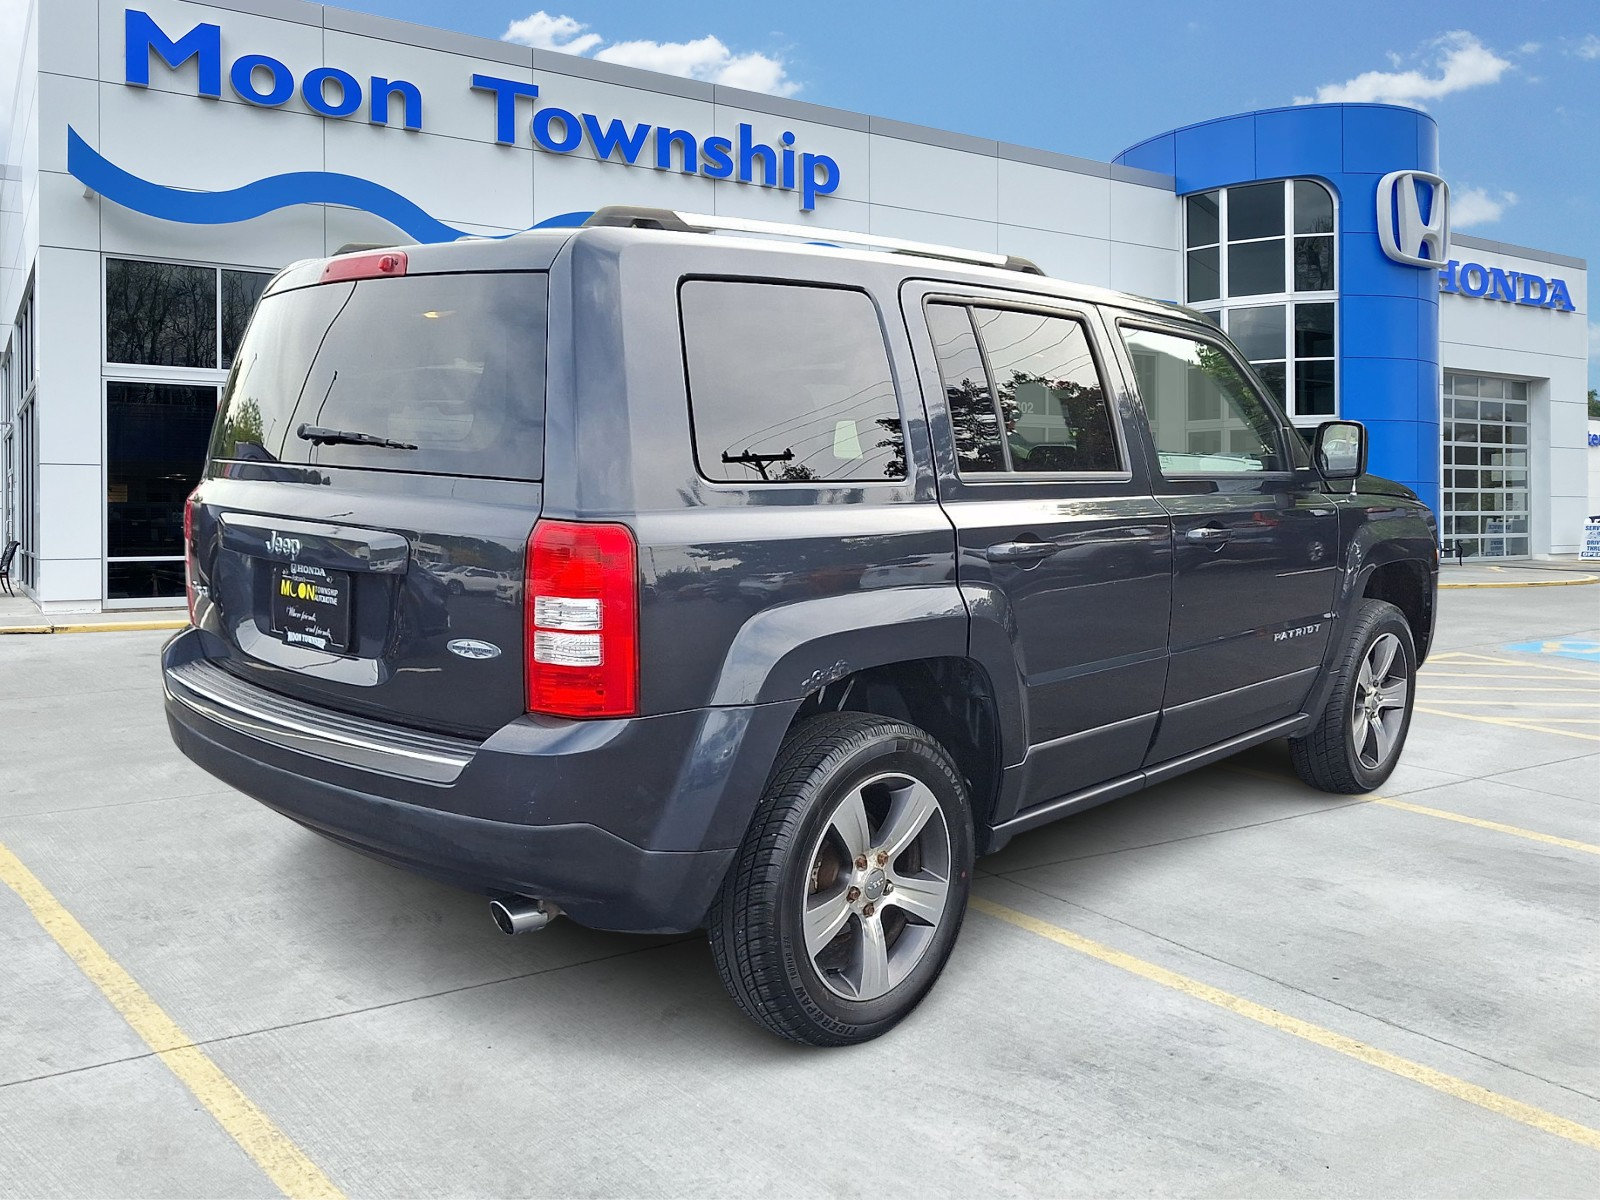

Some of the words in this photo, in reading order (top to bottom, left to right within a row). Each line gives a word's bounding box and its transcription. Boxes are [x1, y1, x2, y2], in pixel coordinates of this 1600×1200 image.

[125, 8, 422, 131] Moon
[470, 73, 840, 212] Township
[1438, 259, 1577, 312] HONDA
[265, 530, 301, 562] Jeep
[297, 564, 326, 577] HONDA
[280, 579, 316, 601] MOON
[1273, 623, 1321, 642] PATRIOT
